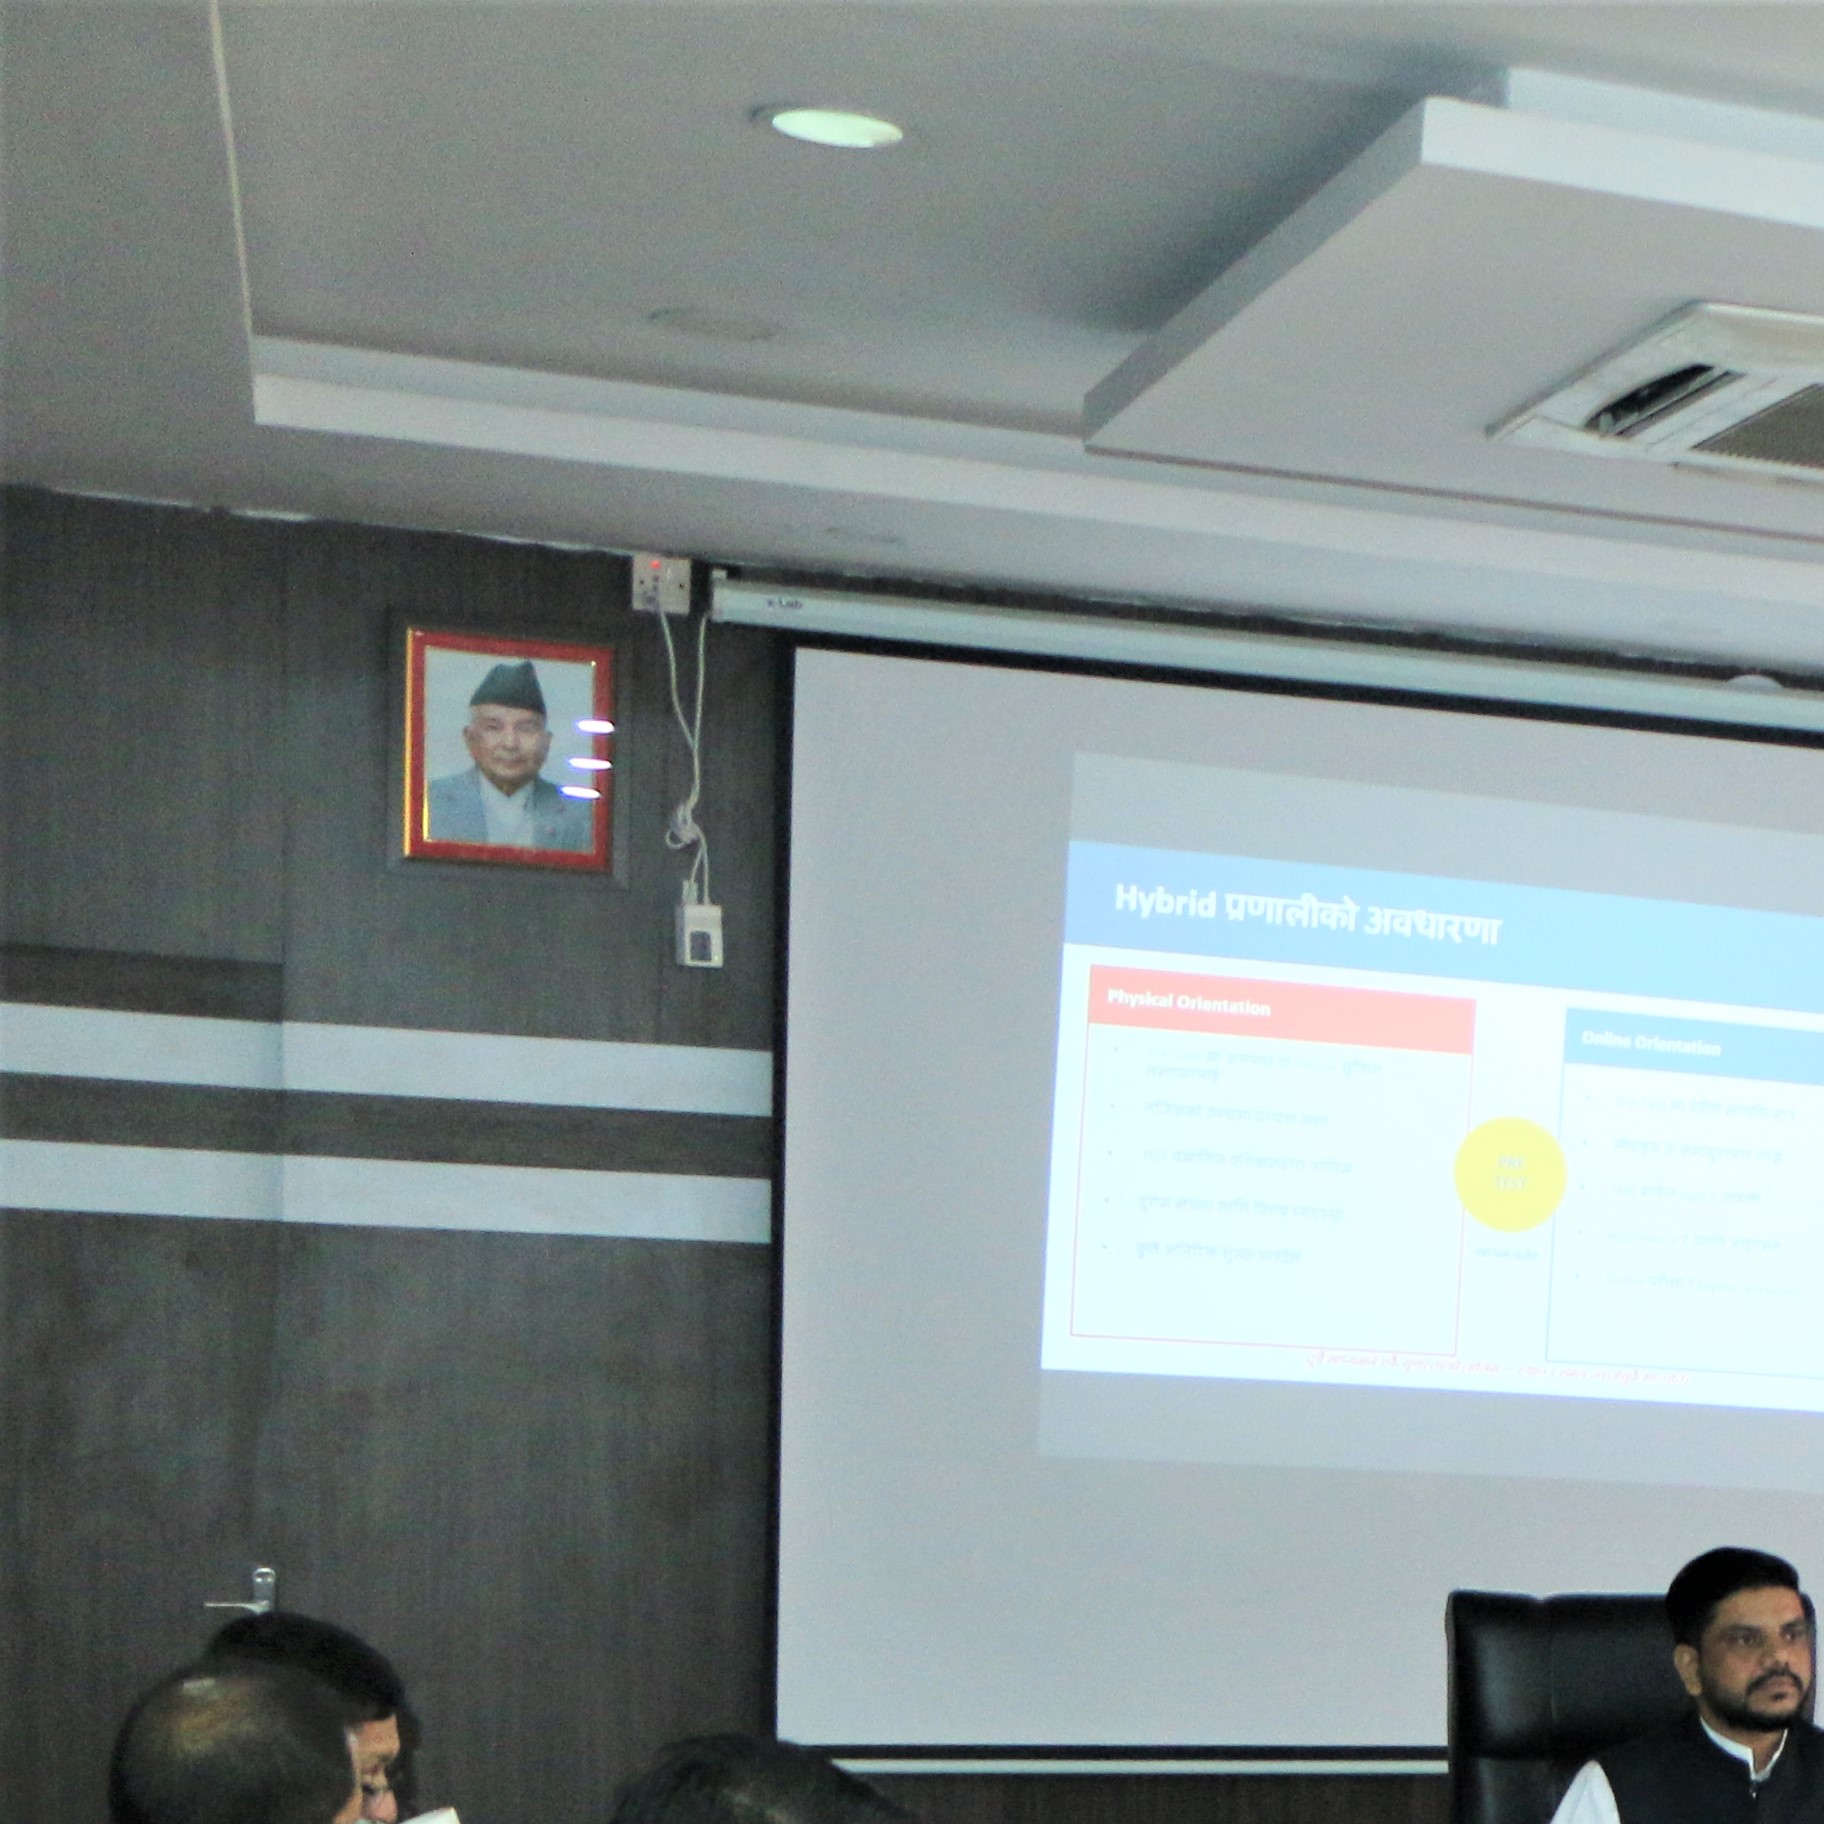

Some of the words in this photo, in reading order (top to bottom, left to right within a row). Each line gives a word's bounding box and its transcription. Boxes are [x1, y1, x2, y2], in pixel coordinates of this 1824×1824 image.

[1114, 883, 1218, 919] Hybrid
[1225, 892, 1360, 933] प्रणालीको
[1363, 904, 1503, 946] अवधारणा
[1107, 988, 1174, 1009] Physical
[1176, 995, 1272, 1017] Orientation
[1581, 1030, 1633, 1050] Online
[1634, 1035, 1723, 1058] Orientation
